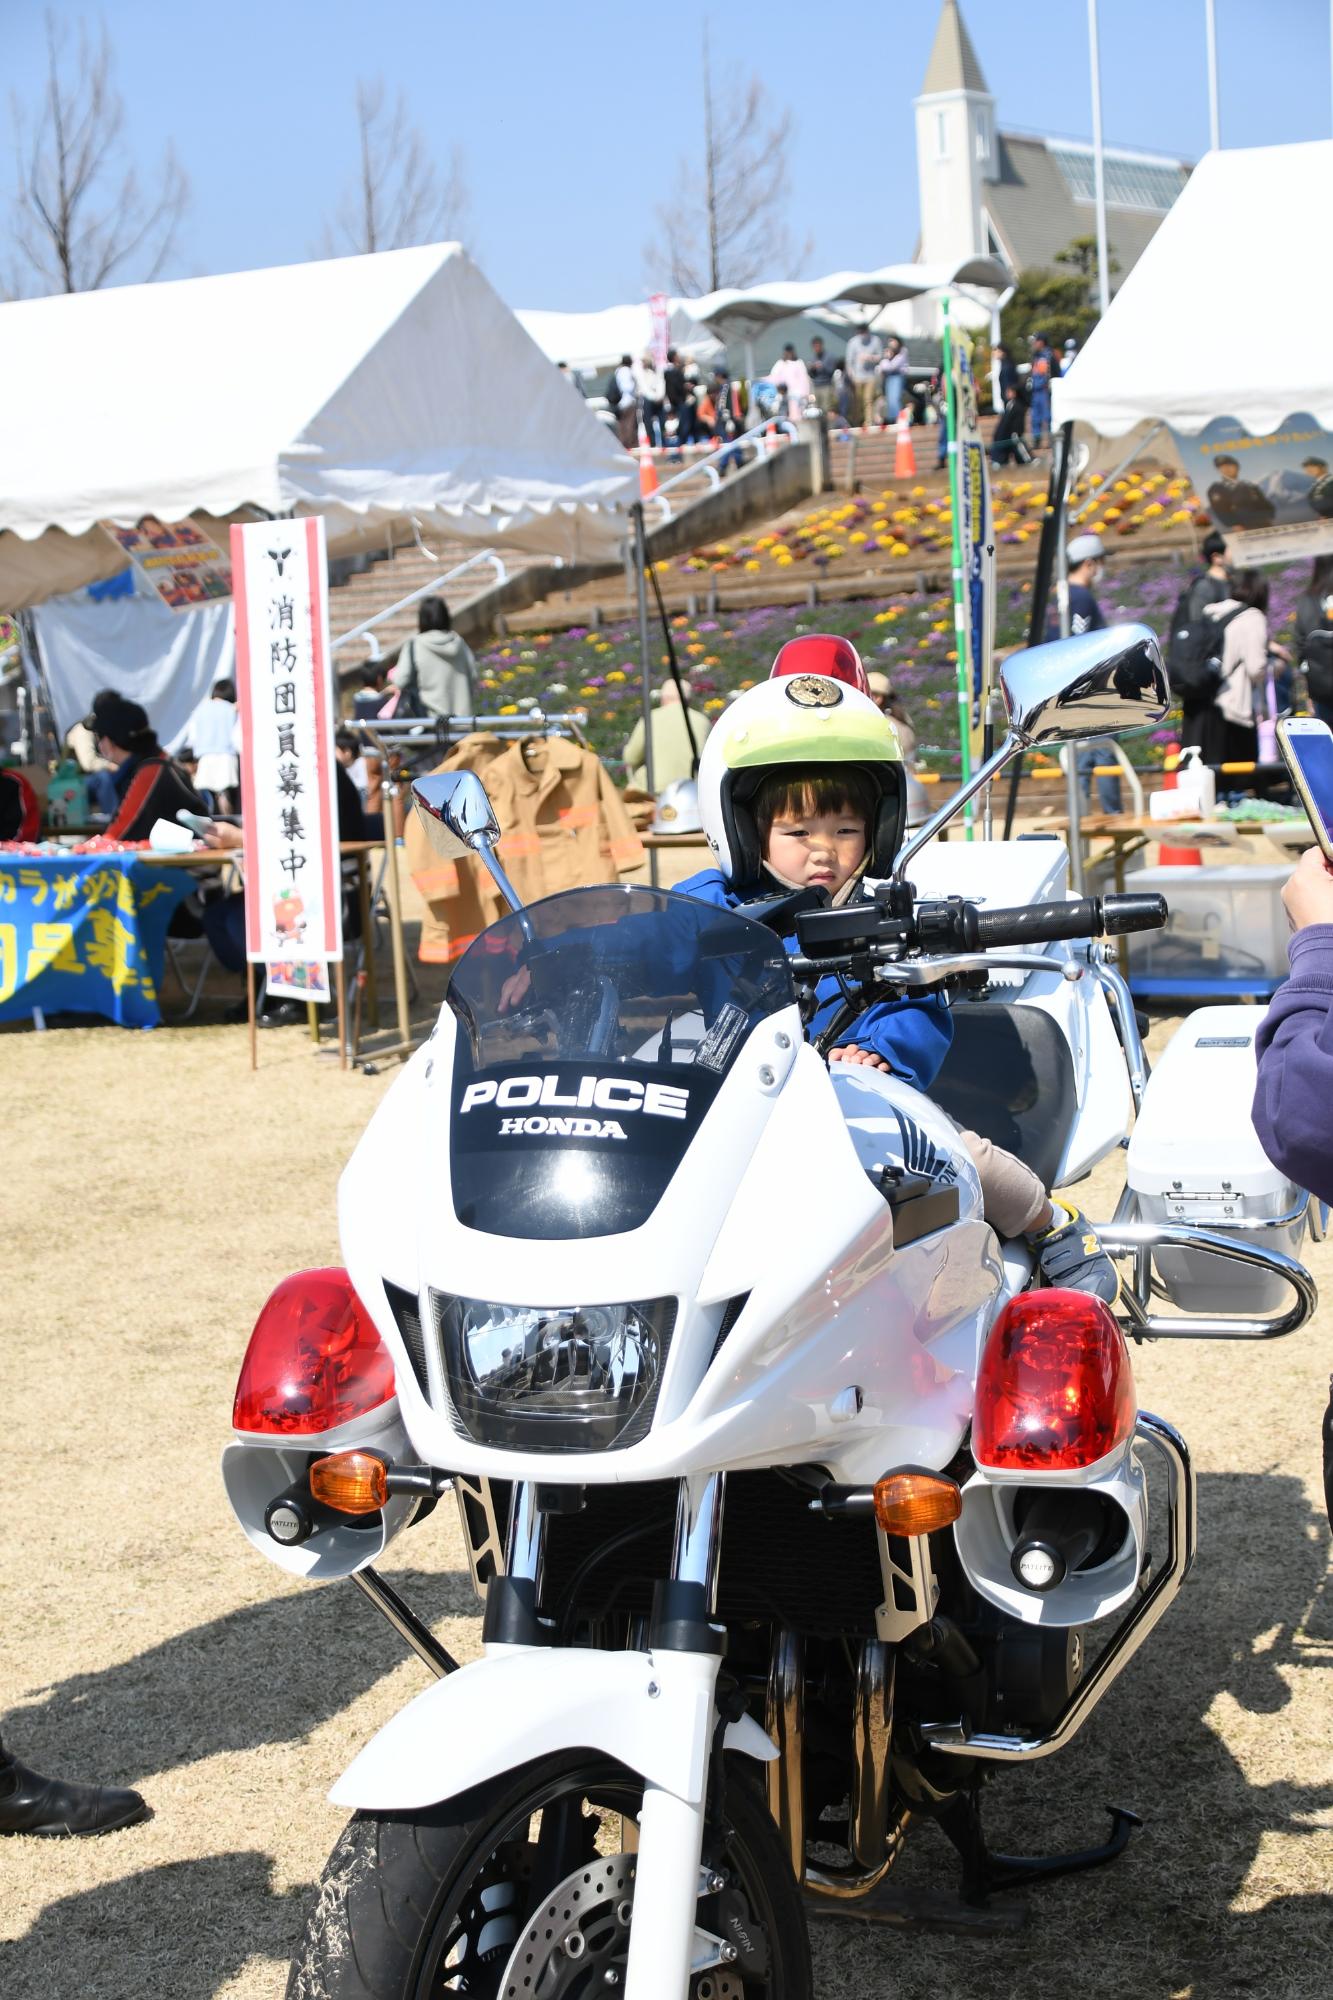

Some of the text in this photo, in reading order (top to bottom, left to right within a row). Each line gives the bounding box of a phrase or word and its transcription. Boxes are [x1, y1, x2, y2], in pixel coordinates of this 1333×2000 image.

[267, 594, 308, 882] 消防団員募集中
[459, 1075, 690, 1120] POLICE
[498, 1117, 628, 1139] HONDA
